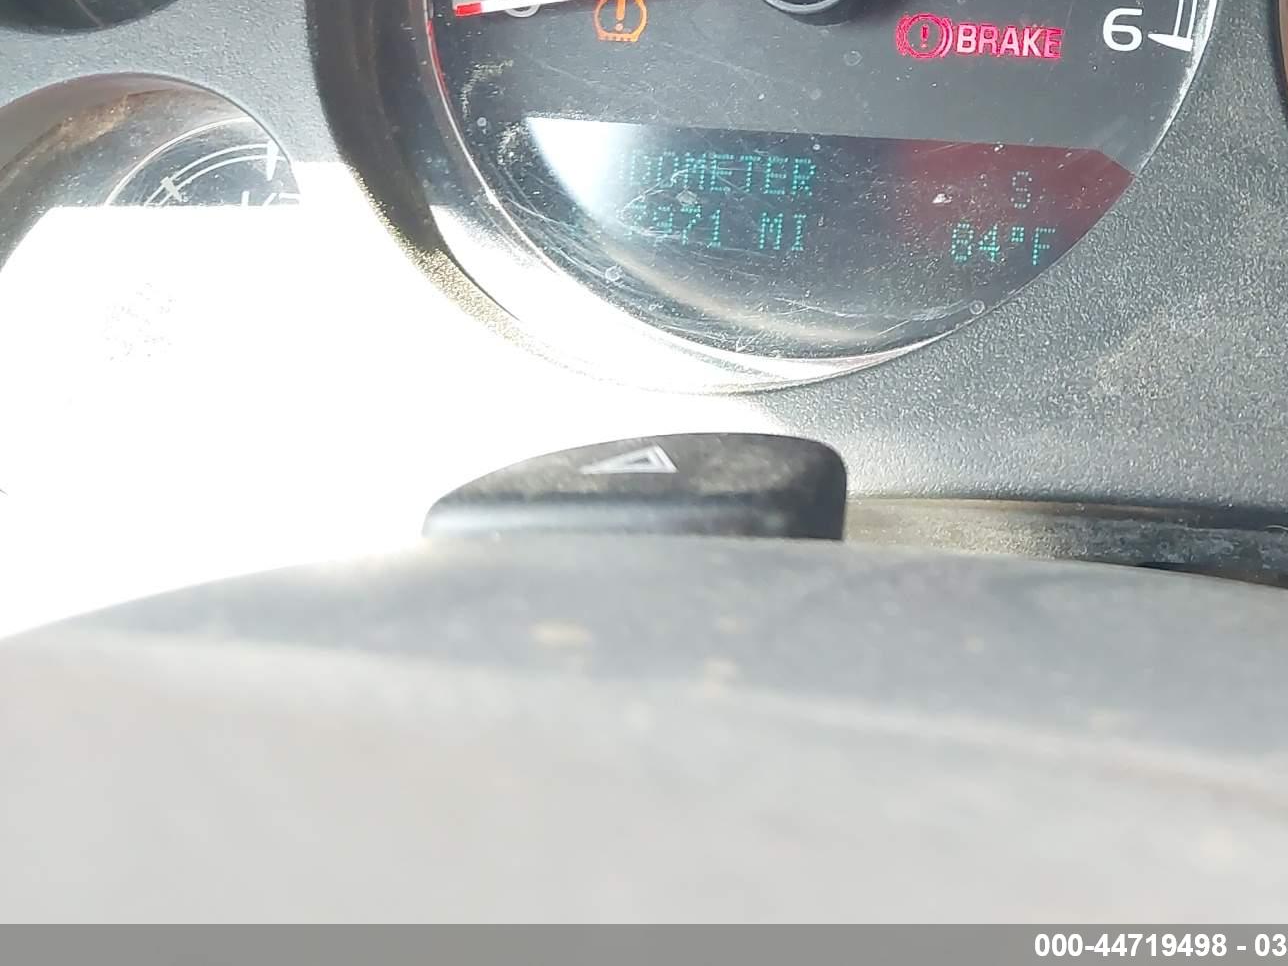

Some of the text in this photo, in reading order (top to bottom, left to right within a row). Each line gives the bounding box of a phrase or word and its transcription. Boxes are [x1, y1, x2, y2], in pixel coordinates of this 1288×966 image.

[956, 24, 1064, 58] BRAKE
[1102, 7, 1143, 52] 6
[759, 211, 808, 251] MI
